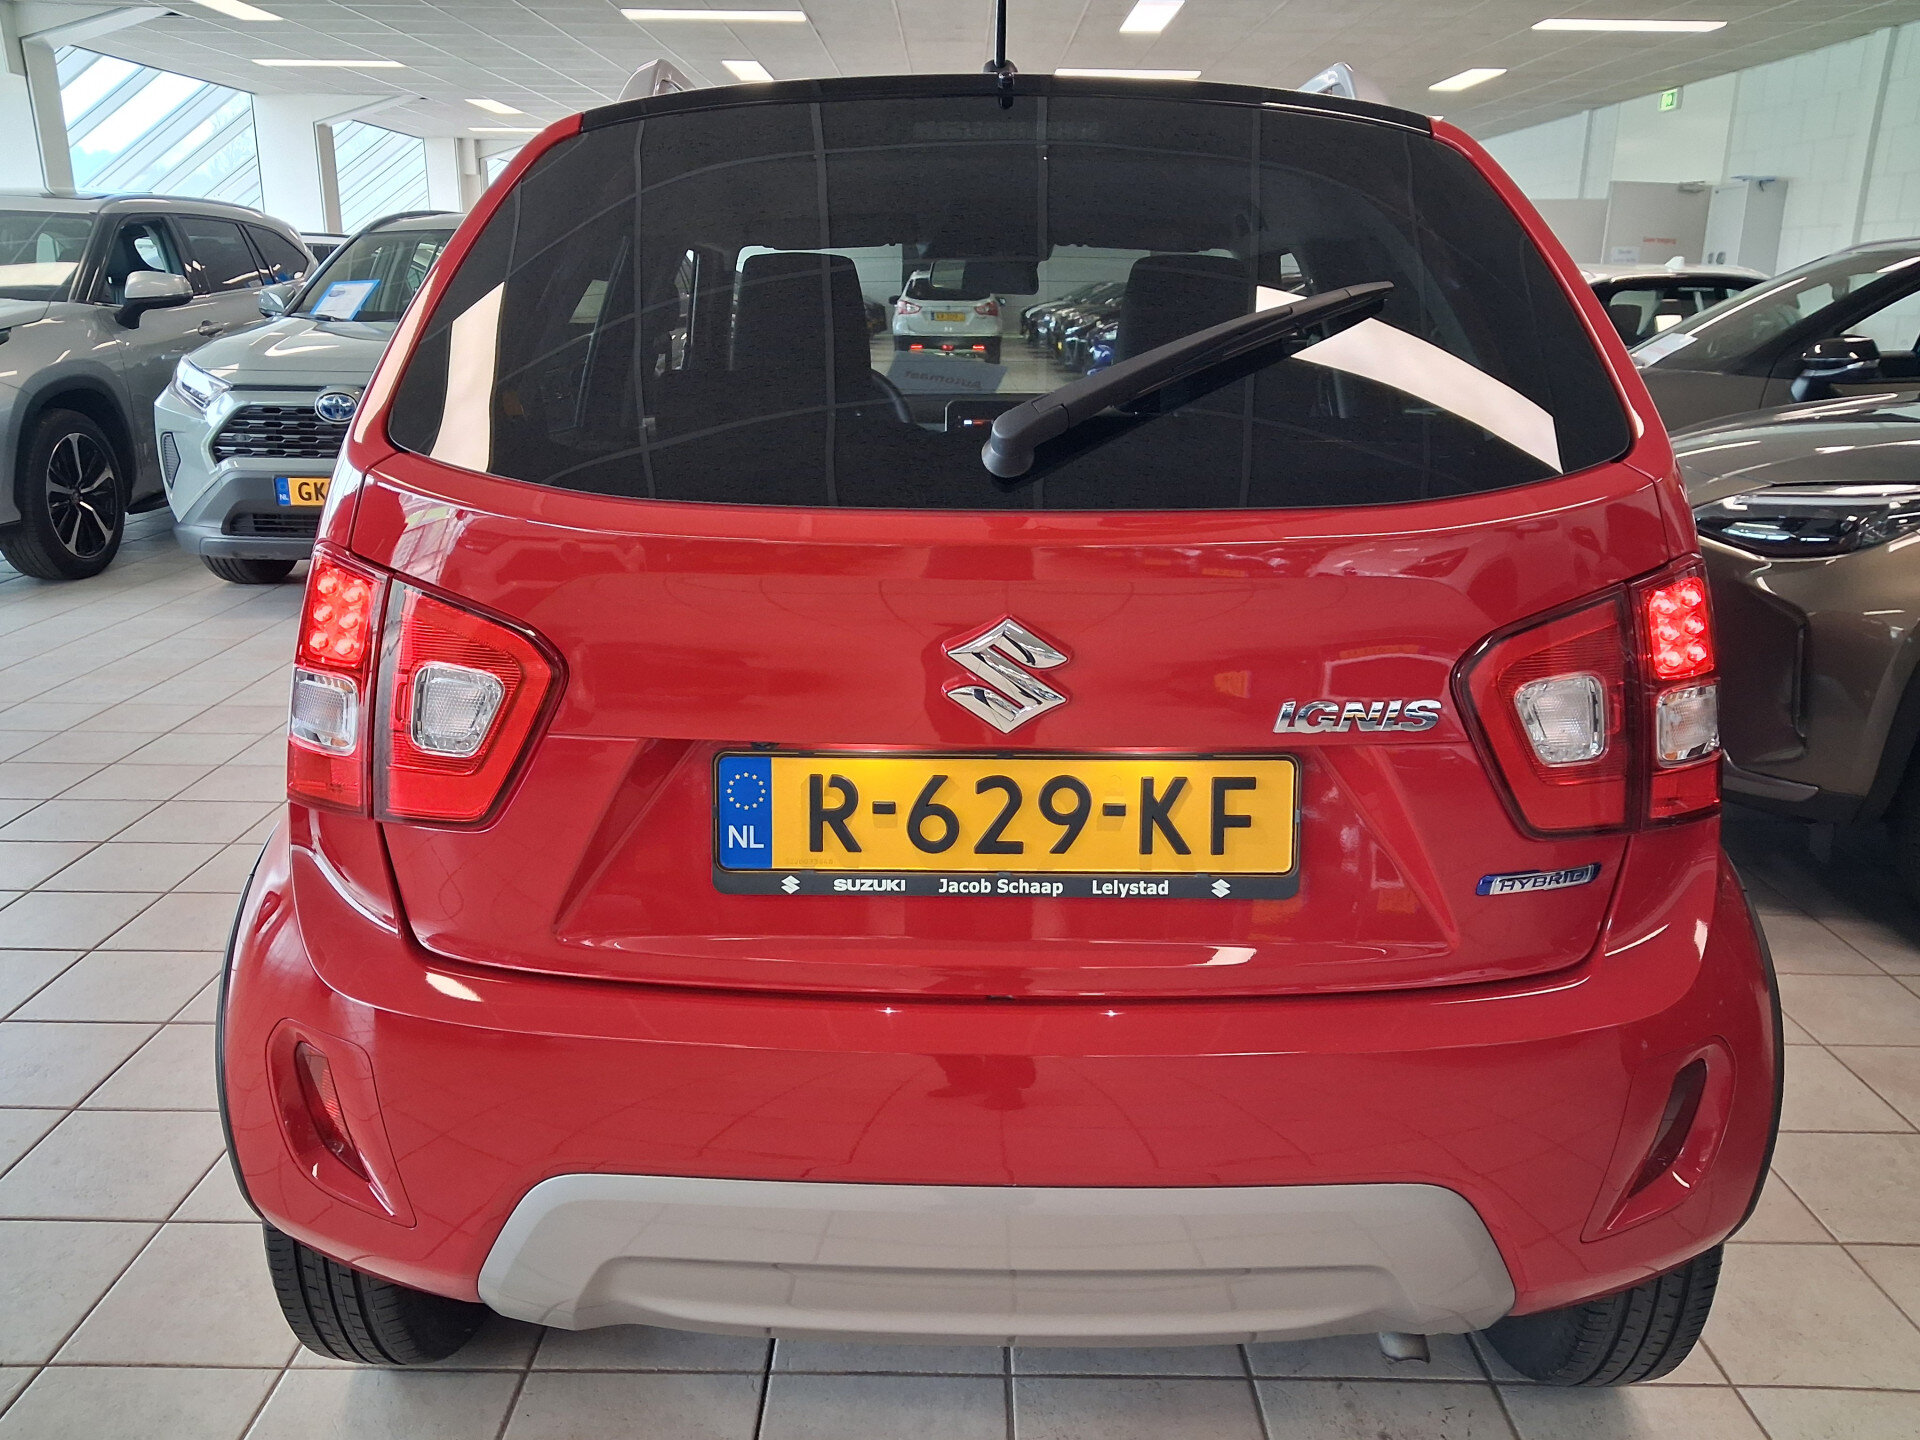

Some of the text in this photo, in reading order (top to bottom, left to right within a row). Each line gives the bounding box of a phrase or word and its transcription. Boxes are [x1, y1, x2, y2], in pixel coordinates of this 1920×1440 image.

[1273, 699, 1442, 734] IGNIS
[807, 773, 1257, 856] R-629-KF
[727, 825, 764, 849] NL
[833, 878, 1169, 898] SUZUKI Jacob Schaap Lelystad
[1498, 868, 1592, 892] HYBRID
